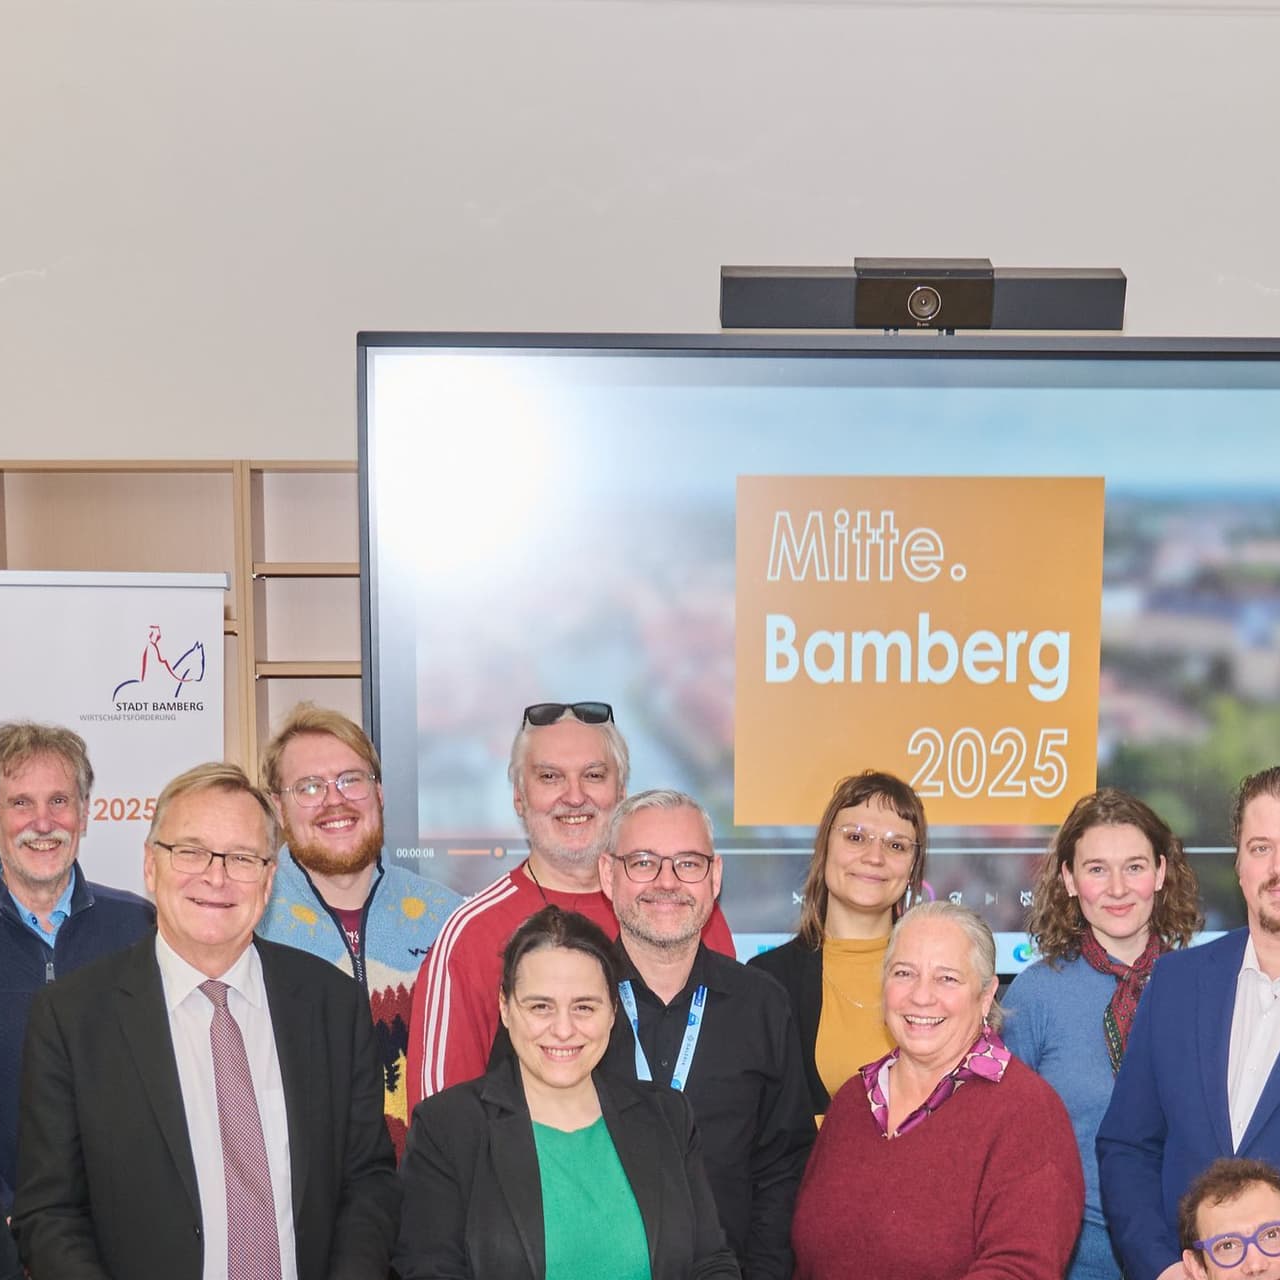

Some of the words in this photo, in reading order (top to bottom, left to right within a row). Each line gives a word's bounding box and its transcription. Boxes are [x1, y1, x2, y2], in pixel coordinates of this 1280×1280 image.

[767, 508, 967, 582] Mitte.
[765, 612, 1070, 702] Bamberg
[116, 702, 149, 712] STADT
[152, 702, 204, 711] BAMBERG
[907, 727, 1069, 799] 2025
